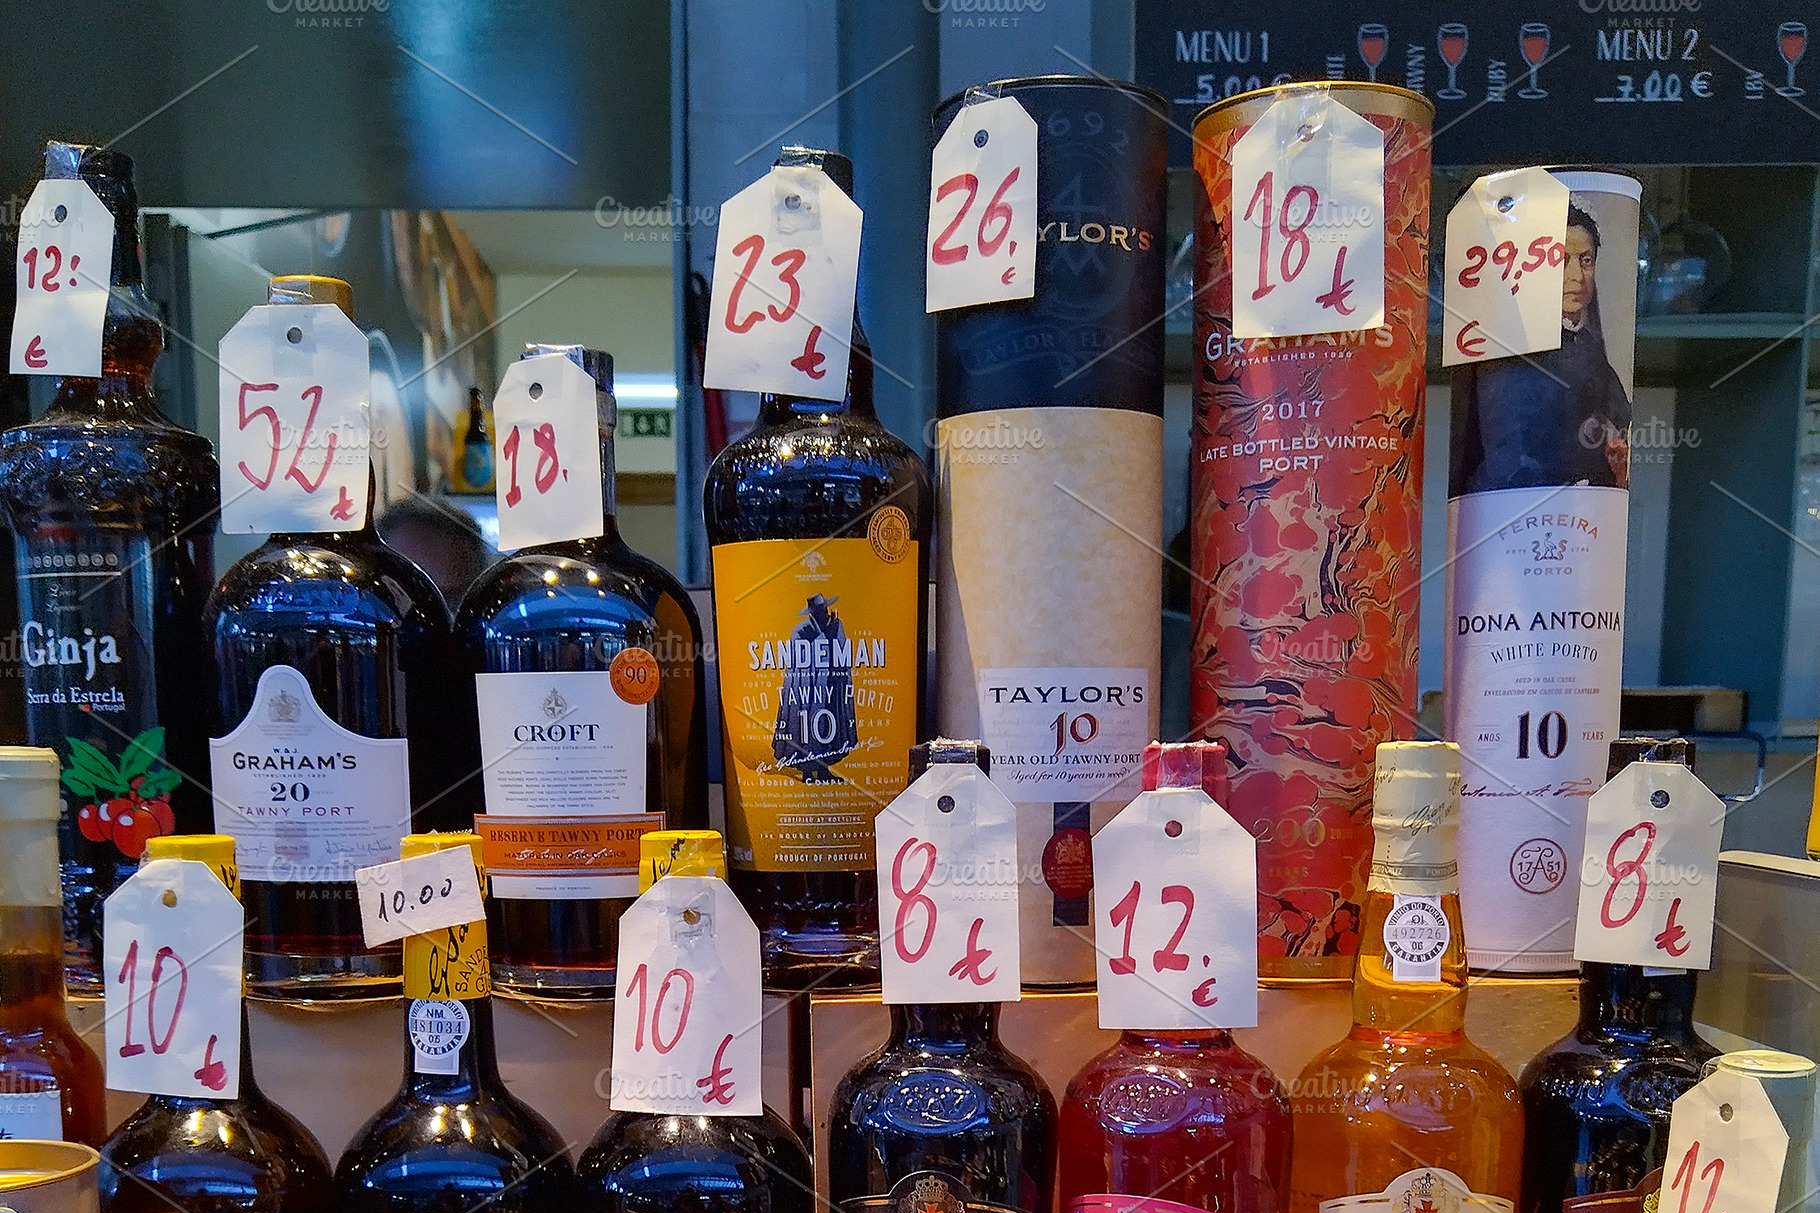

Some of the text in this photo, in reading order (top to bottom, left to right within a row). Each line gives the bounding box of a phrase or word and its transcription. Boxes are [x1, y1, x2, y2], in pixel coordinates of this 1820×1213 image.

[1175, 30, 1270, 63] MENU 1
[1596, 29, 1700, 61] MENU 2
[1243, 171, 1321, 302] 18
[724, 235, 807, 335] 23
[1261, 400, 1326, 422] 2017
[1200, 435, 1398, 463] LATE BOTTLED VINTAGE
[1259, 455, 1324, 474] PORT
[1499, 513, 1599, 541] FERREIRA
[1523, 566, 1573, 577] PORTO
[1458, 610, 1621, 636] DONA ANTONIA
[23, 619, 122, 682] Ginja
[748, 638, 886, 671] SANDEMAN
[1490, 642, 1599, 664] WHITE PORTO
[625, 665, 647, 685] 90
[26, 685, 124, 705] Serra da Estrela
[742, 684, 894, 716] OLD TAWNY PORTO
[988, 685, 1144, 707] TAYLOR'S
[513, 723, 600, 743] CROFT
[798, 708, 837, 745] 10
[1049, 711, 1100, 757] 10
[1515, 710, 1570, 760] 10
[233, 751, 358, 771] GRAHAM'S
[991, 752, 1140, 765] YEAR OLD TAWNY PORT
[270, 781, 310, 802] 20
[238, 806, 354, 817] TAWNY PORT
[489, 827, 646, 844] RESERVE TAWNY PORT
[1600, 821, 1656, 928] 8
[378, 878, 452, 923] 10.00
[891, 836, 938, 963] 8
[1391, 929, 1442, 940] 492726
[118, 939, 189, 1059] 10
[625, 963, 695, 1055] 10
[426, 1008, 444, 1019] NM
